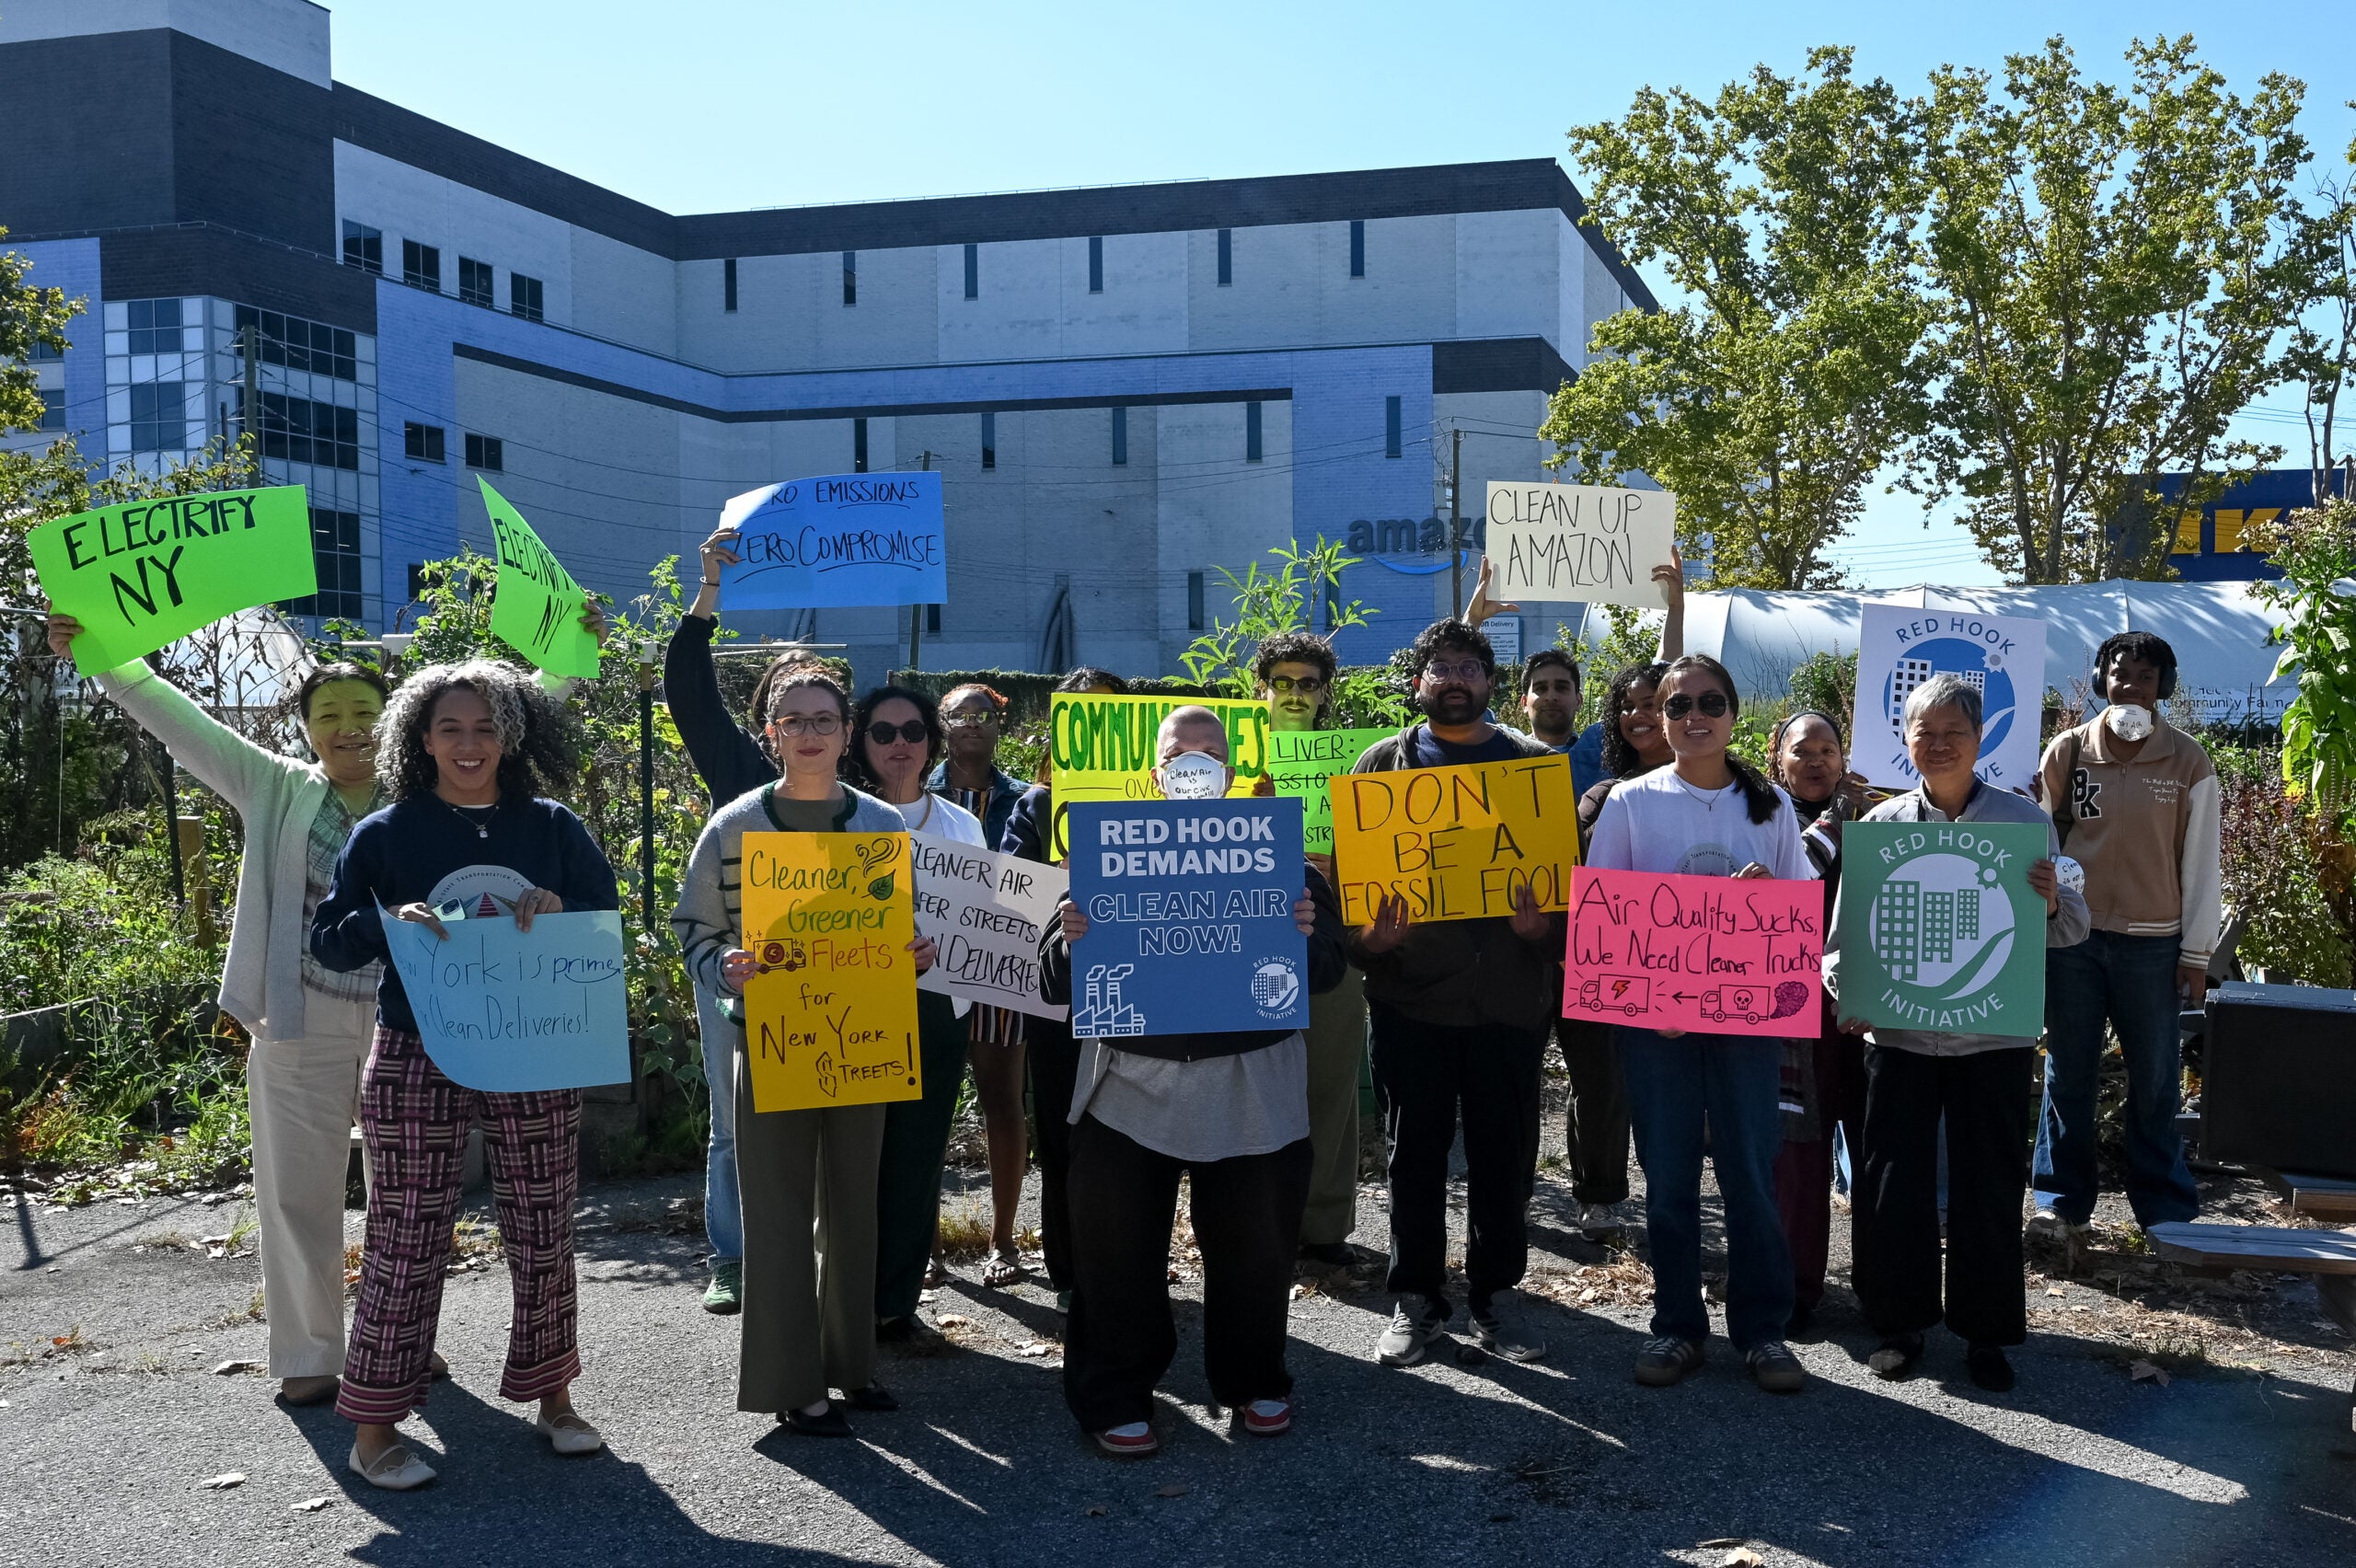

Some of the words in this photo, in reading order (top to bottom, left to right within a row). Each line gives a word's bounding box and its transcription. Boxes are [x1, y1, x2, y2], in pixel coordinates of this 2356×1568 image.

[815, 479, 919, 503] EMISSIONS
[1490, 489, 1579, 527] CLEAN
[1599, 493, 1643, 534] UP
[63, 494, 258, 571] ELECTRIFY
[798, 525, 940, 566] COMPROMISE
[1346, 516, 1487, 554] amazo
[1507, 533, 1633, 589] AMAZON
[110, 545, 184, 627] NY
[532, 594, 572, 654] NY
[1895, 618, 1939, 643] RED
[1950, 617, 2015, 655] HOOK
[1052, 700, 1268, 778] COMMUNES
[1269, 734, 1354, 762] LIVER:
[1126, 778, 1161, 798] OVE
[1352, 764, 1561, 831] DON'T
[2073, 767, 2101, 820] BK
[1100, 819, 1169, 845] RED
[1177, 816, 1275, 843] HOOK
[1393, 826, 1464, 873] BE
[1490, 823, 1524, 863] A
[1878, 832, 1925, 864] RED
[1938, 829, 2013, 870] HOOK
[749, 849, 861, 895] Cleaner,
[1101, 847, 1275, 877] DEMANDS
[999, 869, 1033, 898] AIR
[789, 898, 895, 933] Greener
[960, 905, 1039, 943] STREETS
[1089, 892, 1215, 922] CLEAN
[1223, 889, 1288, 918] AIR
[1576, 877, 1640, 926] Air
[1650, 882, 1737, 935] Quality
[1739, 893, 1819, 936] Sucks,
[418, 934, 502, 987] York
[517, 951, 543, 981] is
[553, 955, 615, 985] prime
[812, 937, 893, 972] Fleets
[1139, 925, 1241, 955] NOW!
[1574, 923, 1613, 965] We
[1627, 928, 1680, 973] Need
[1686, 932, 1754, 975] Cleaner
[1761, 934, 1821, 974] Trucks
[946, 935, 1039, 992] DELIVERIE
[1253, 957, 1268, 969] RED
[1273, 955, 1297, 968] HOOK
[486, 986, 589, 1040] Deliveries!
[799, 983, 837, 1010] for
[1256, 1006, 1297, 1020] INITIATIVE
[1880, 987, 2004, 1028] INITIATIVE
